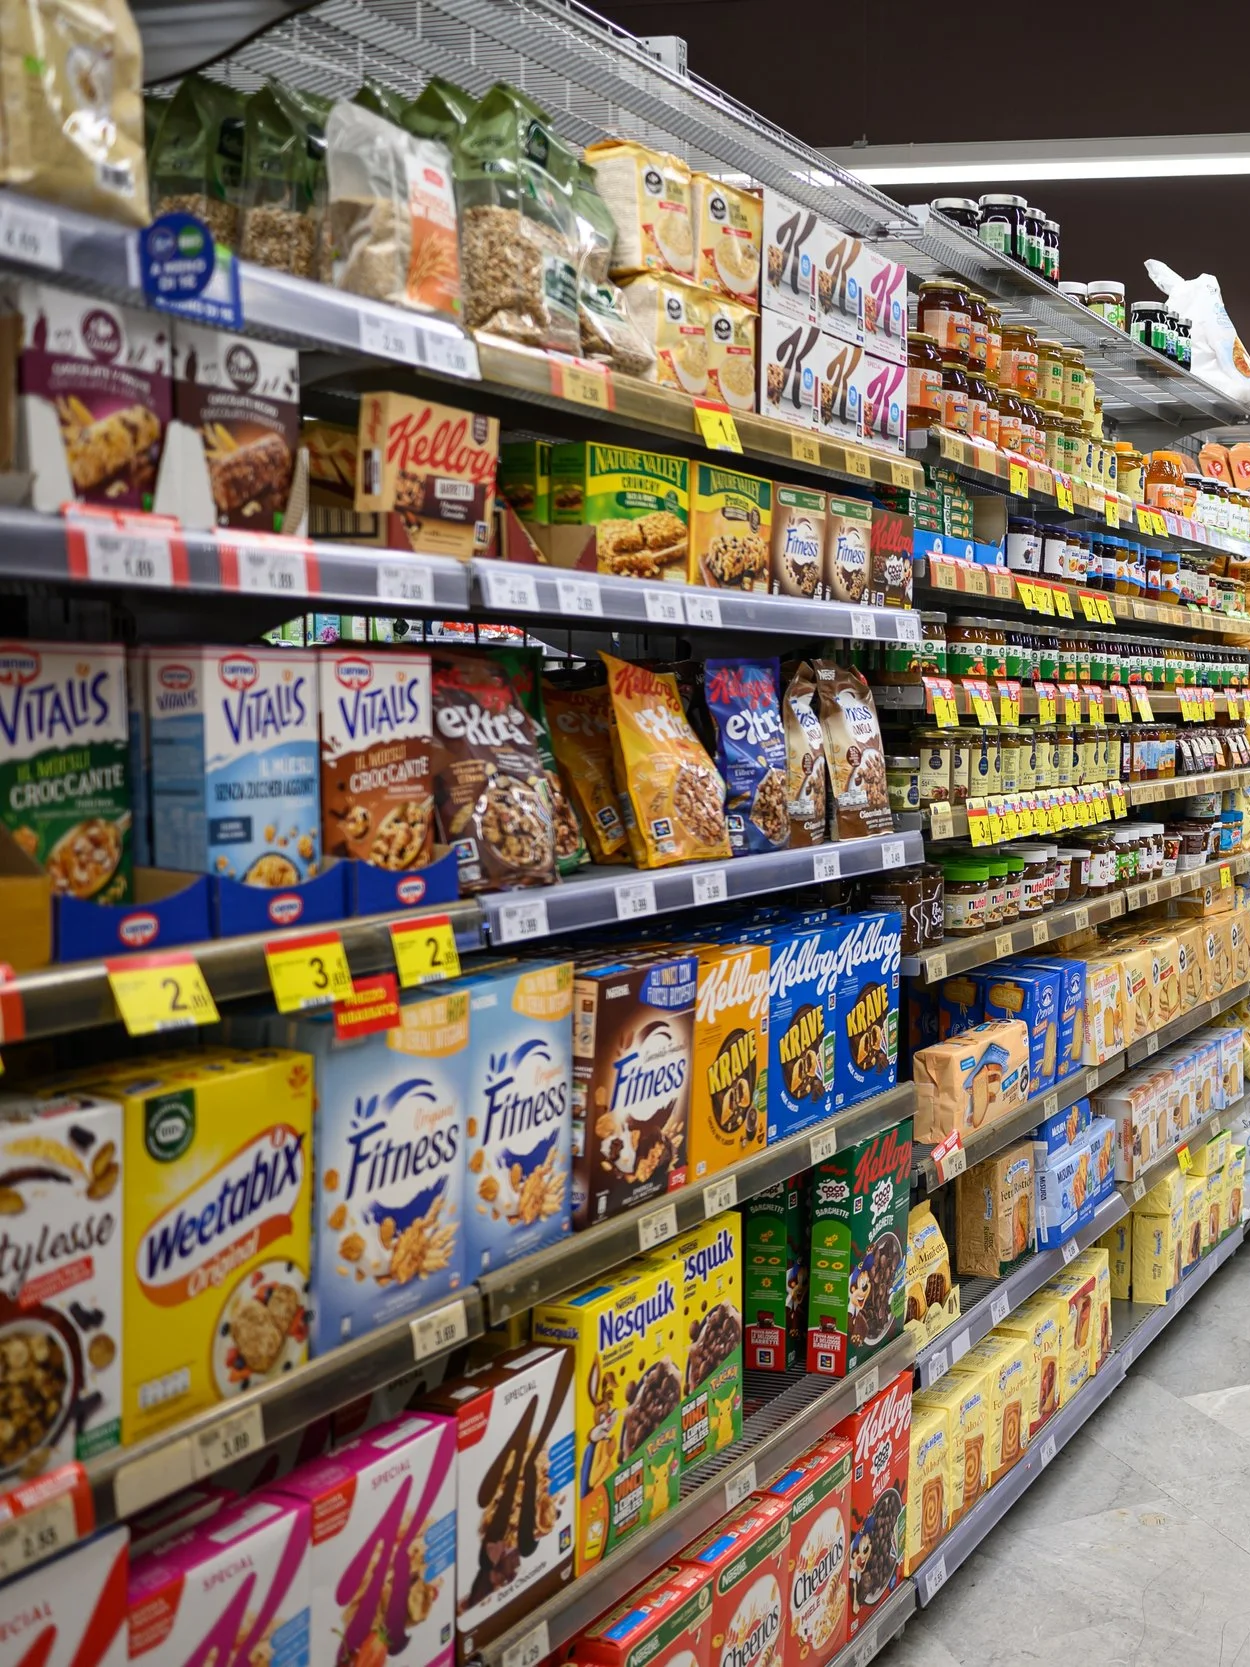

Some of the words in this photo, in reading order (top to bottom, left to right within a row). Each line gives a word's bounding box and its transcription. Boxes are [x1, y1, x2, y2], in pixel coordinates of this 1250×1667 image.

[1064, 442, 1079, 452] BIO
[595, 446, 643, 475] NATURE
[642, 453, 684, 487] VALLEY
[710, 470, 739, 493] NATURE
[739, 478, 760, 503] VALLEY
[785, 528, 819, 557] Fitness
[837, 537, 866, 565] Fitness
[9, 763, 125, 811] CROCCANTE
[350, 755, 430, 794] CROCCANTE
[968, 896, 987, 911] nutell
[425, 937, 441, 968] 2
[309, 957, 329, 990] 3
[160, 977, 188, 1012] 2
[846, 983, 889, 1038] KRAVE
[778, 1004, 825, 1065] KRAVE
[707, 1029, 757, 1096] KRAVE
[609, 1052, 686, 1112] Fitness
[482, 1076, 568, 1147] Fitness
[345, 1120, 459, 1202] Fitness
[146, 1132, 306, 1280] Weetabix
[821, 1184, 846, 1193] COCO
[874, 1183, 891, 1202] COCO
[750, 1203, 785, 1214] BARCHETTE
[815, 1207, 850, 1219] BARCHETTE
[867, 1214, 894, 1243] BARCHETTE
[0, 1212, 114, 1301] tylesse
[187, 1228, 260, 1298] Original
[684, 1229, 734, 1284] squik
[535, 1323, 580, 1341] Nesquik
[599, 1280, 675, 1352] Nesquik
[751, 1338, 779, 1346] BARRETTE
[813, 1342, 841, 1351] BARRETTE
[503, 1379, 538, 1406] SPECIAL
[370, 1458, 412, 1490] SPECIAL
[202, 1554, 253, 1592] SPECIAL
[793, 1536, 844, 1609] Cheerios
[3, 1600, 54, 1640] ECIAL
[800, 1596, 821, 1624] MIELE
[722, 1604, 779, 1667] Cheerios
